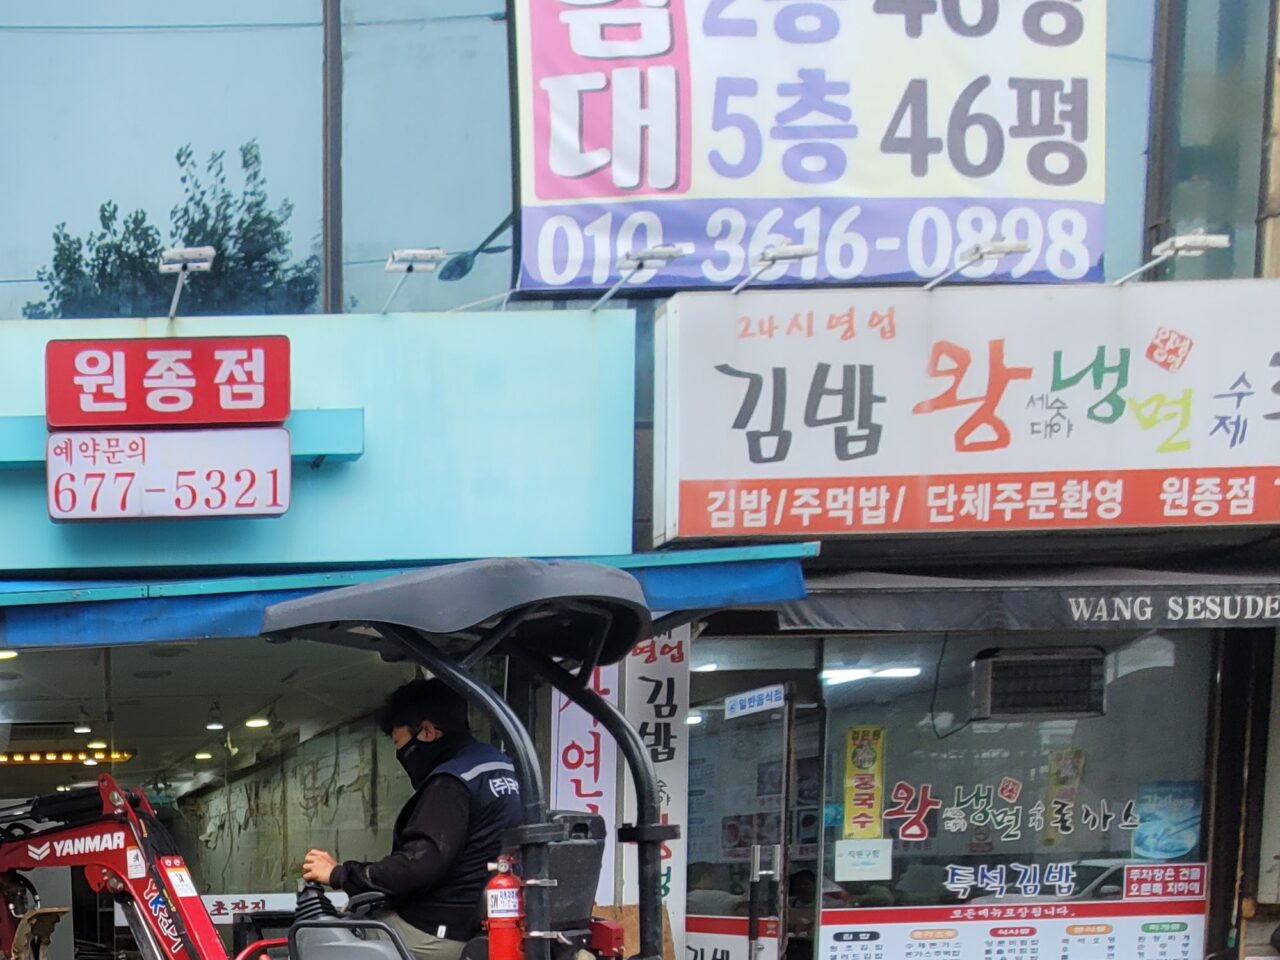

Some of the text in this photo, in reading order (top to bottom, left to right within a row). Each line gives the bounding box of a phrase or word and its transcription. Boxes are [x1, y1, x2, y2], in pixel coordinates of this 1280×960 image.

[708, 68, 1088, 187] 5층 46평
[536, 204, 1092, 286] 010-3616-0898
[73, 348, 266, 412] 원종점
[714, 361, 888, 465] 김밥
[53, 436, 147, 466] 예약문의
[53, 468, 285, 513] 677-5321
[926, 477, 1125, 523] 단체주문환영
[1159, 475, 1257, 518] 원종점
[1068, 596, 1153, 623] WANG
[852, 773, 876, 830] 콩국수
[53, 831, 124, 857] YANMAR
